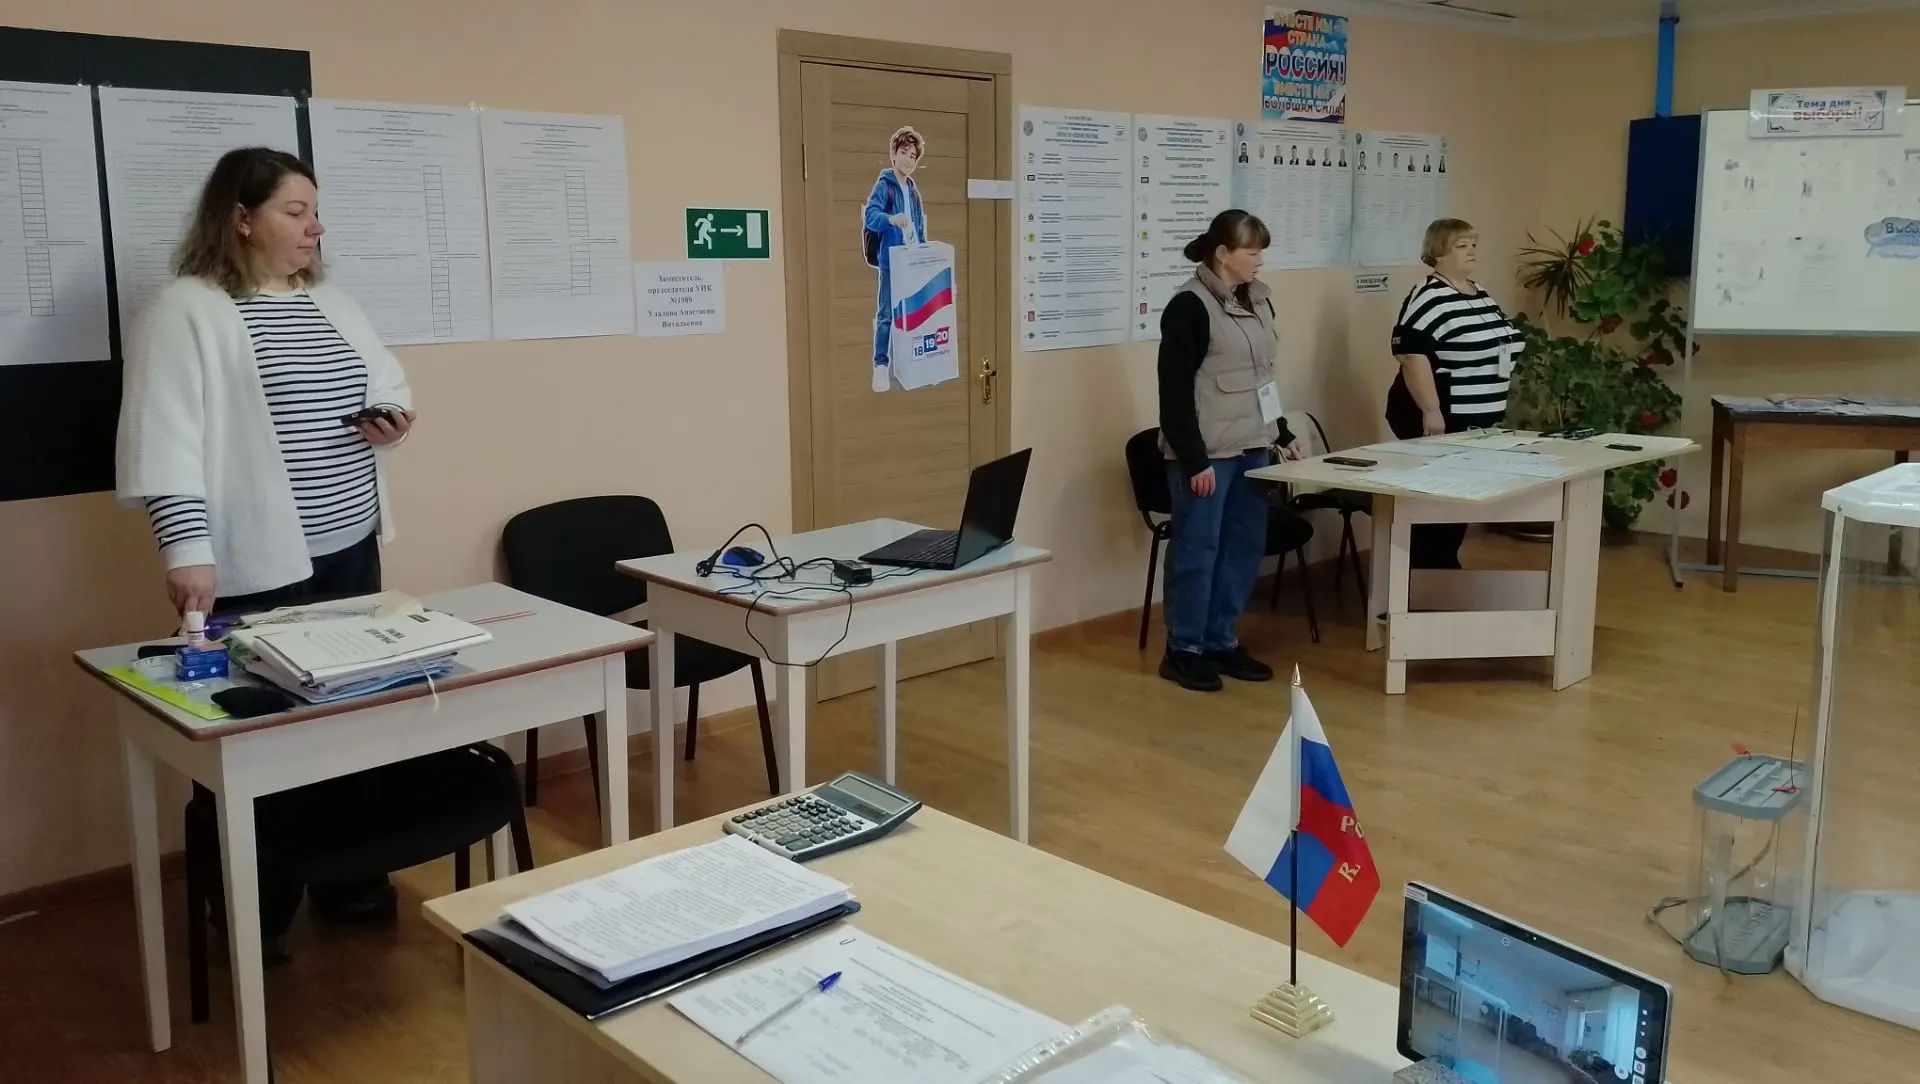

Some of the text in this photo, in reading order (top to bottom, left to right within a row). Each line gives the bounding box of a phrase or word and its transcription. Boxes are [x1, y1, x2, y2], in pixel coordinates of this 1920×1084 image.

[1287, 30, 1326, 48] СТРАНА
[1264, 44, 1346, 84] РОССИЯ!
[1263, 95, 1314, 113] БОЛЬШАЯ
[1796, 99, 1826, 109] Тема
[1828, 99, 1851, 109] дня
[659, 274, 702, 282] Заместитель
[647, 286, 694, 295] председателя
[914, 346, 924, 357] 18
[925, 338, 935, 349] 19
[936, 330, 948, 342] 20
